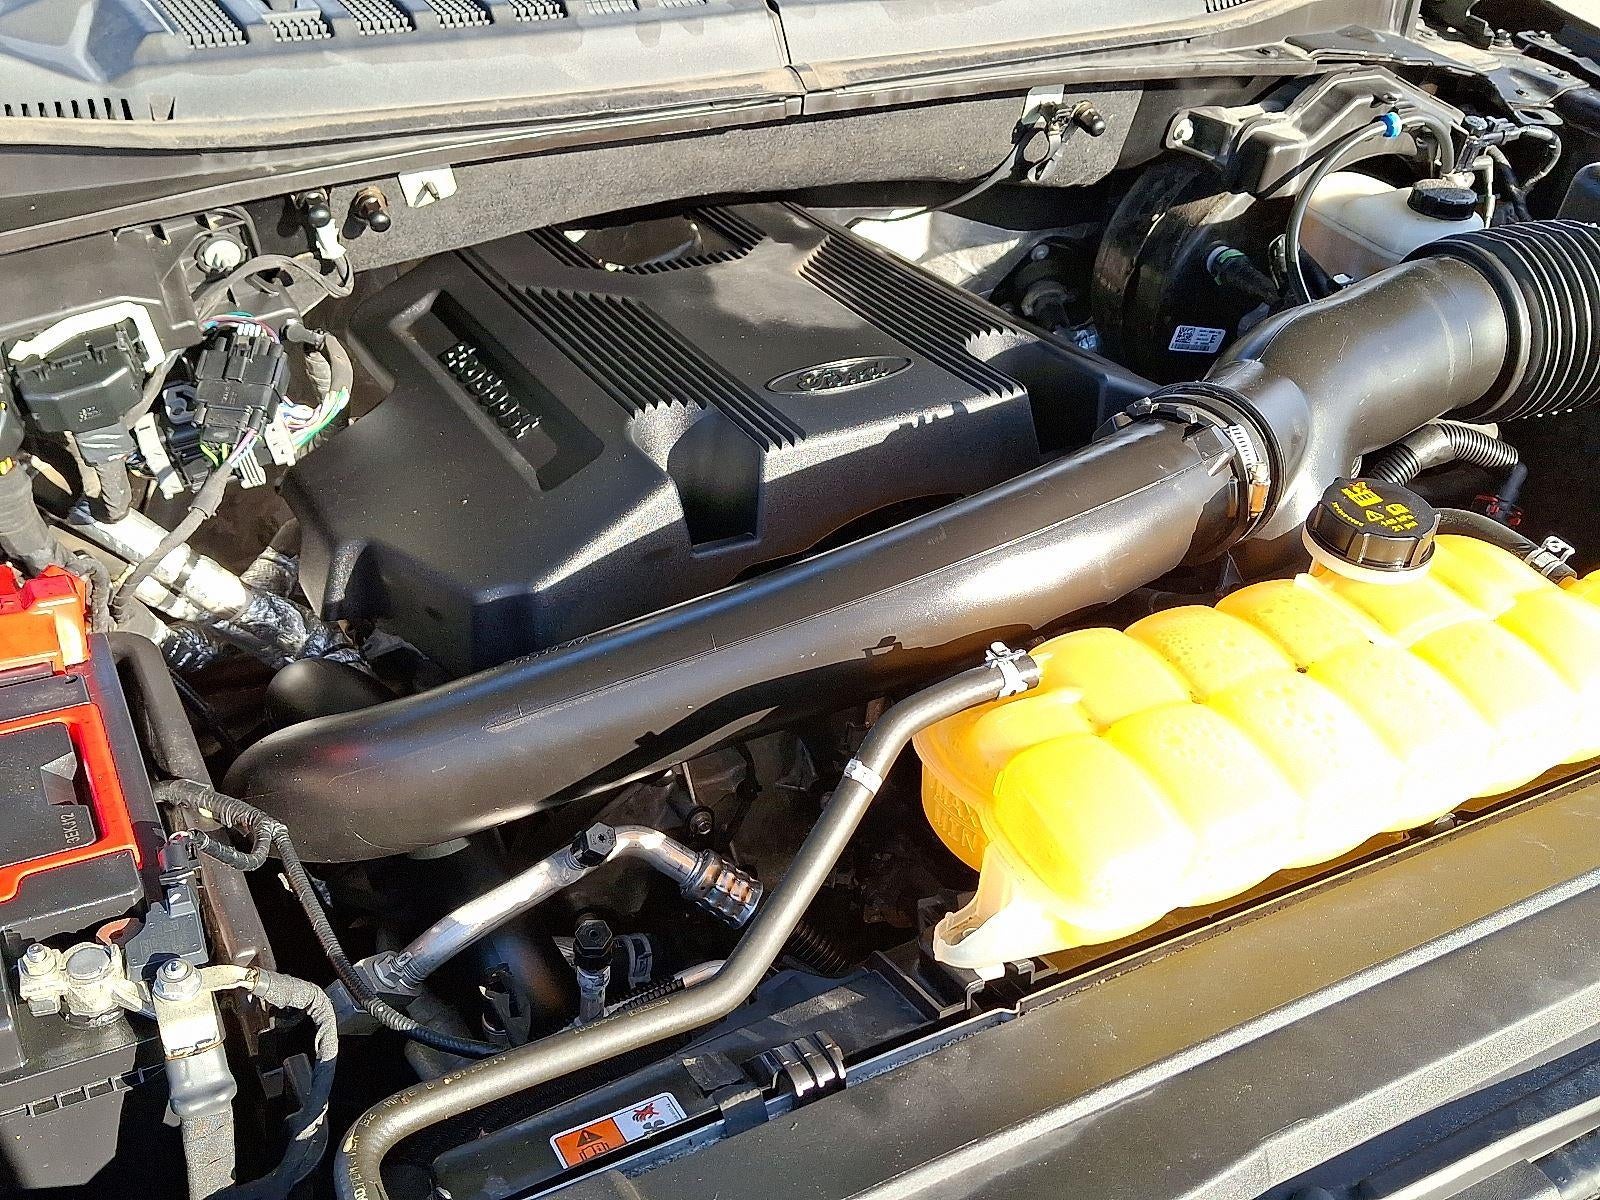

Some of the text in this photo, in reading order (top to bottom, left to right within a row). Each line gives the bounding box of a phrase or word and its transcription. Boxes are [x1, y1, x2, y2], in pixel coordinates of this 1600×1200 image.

[794, 359, 894, 392] Ford
[932, 780, 978, 828] MAX
[932, 808, 978, 853] MIN
